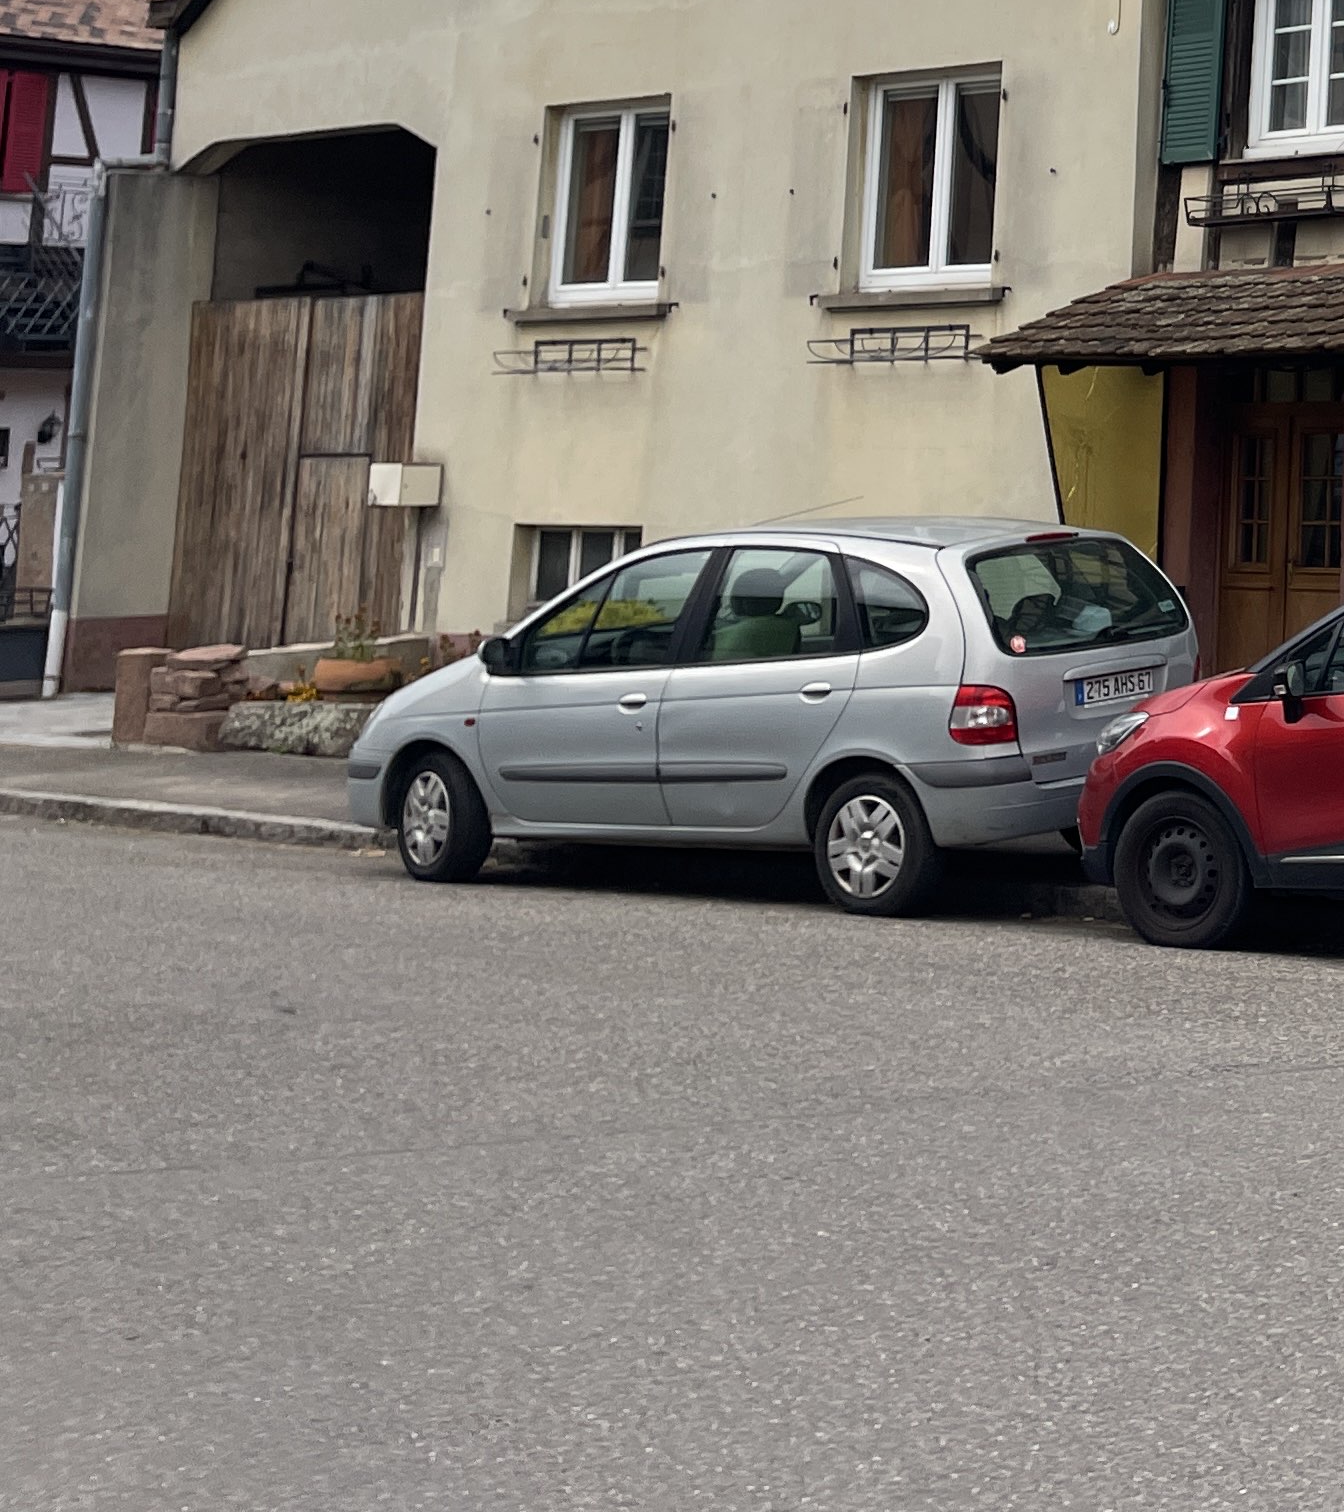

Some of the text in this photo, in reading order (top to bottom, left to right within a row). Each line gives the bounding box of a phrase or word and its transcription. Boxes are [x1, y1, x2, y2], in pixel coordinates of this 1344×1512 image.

[1086, 671, 1152, 700] 275 AHS 67
